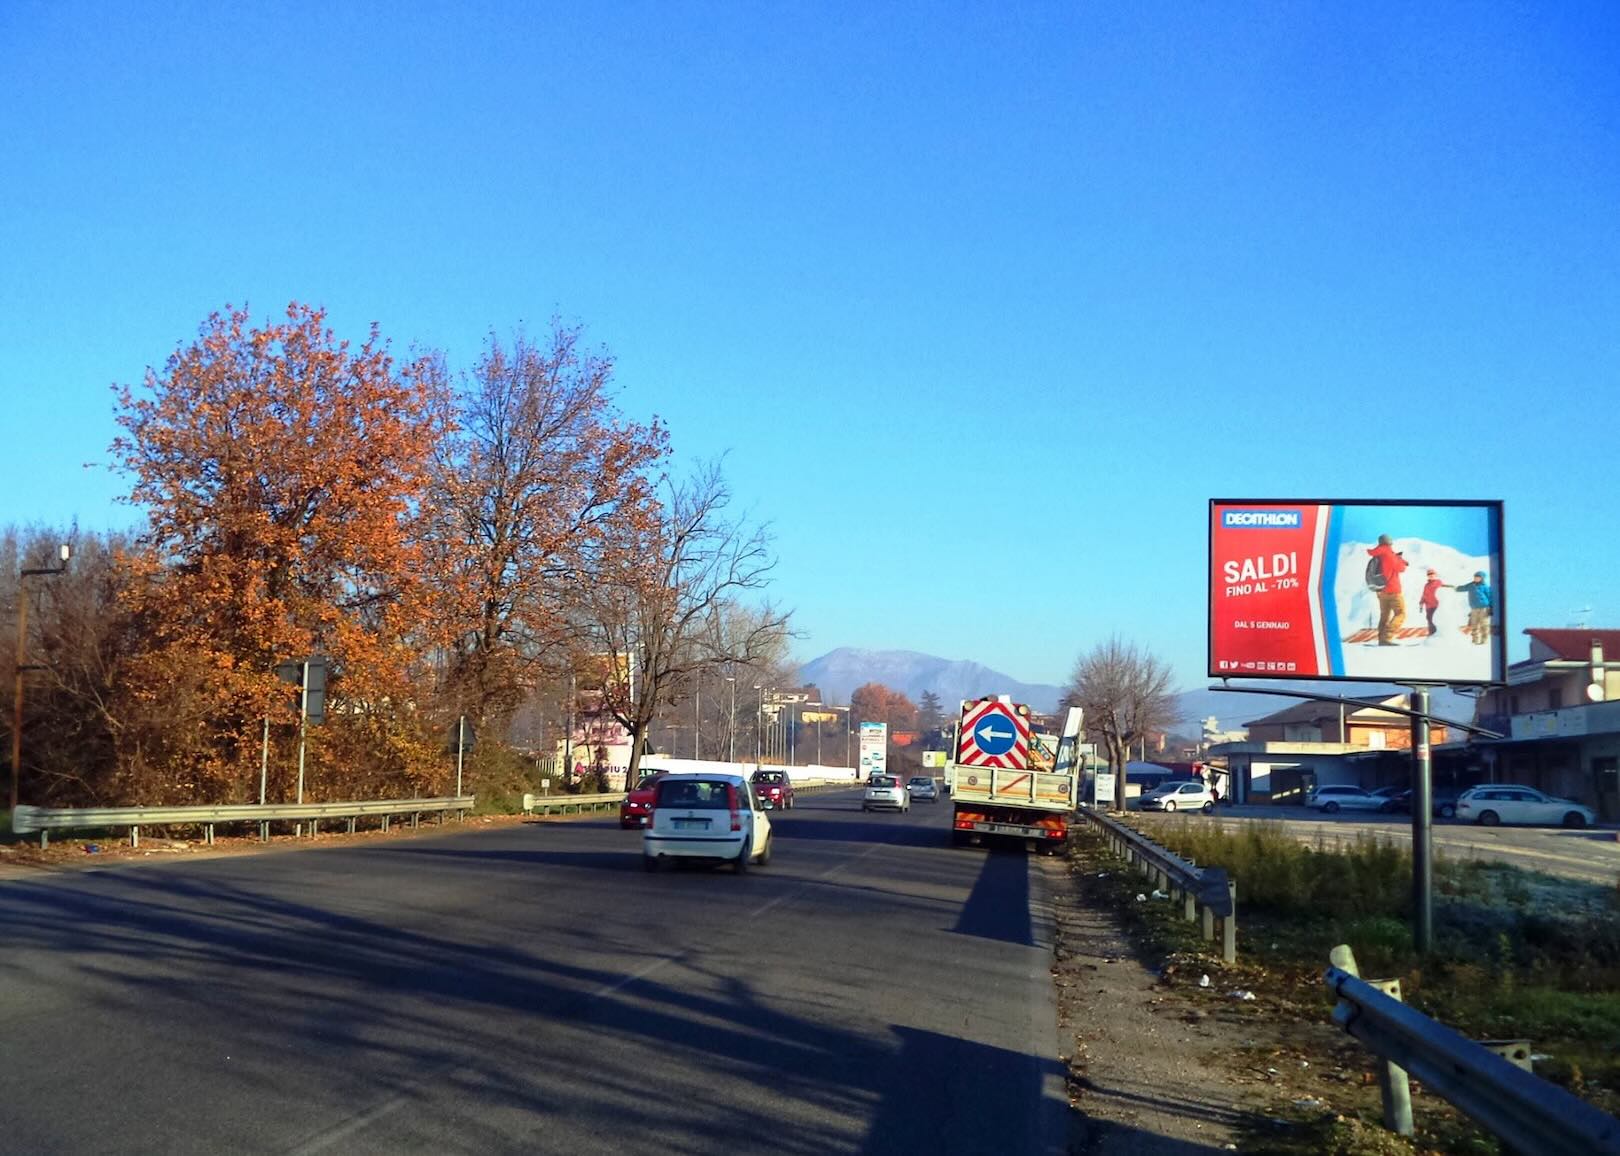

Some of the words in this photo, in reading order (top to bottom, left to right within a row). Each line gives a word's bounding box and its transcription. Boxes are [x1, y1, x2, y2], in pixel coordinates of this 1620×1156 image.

[1226, 513, 1298, 525] DECATHLON
[1223, 552, 1297, 584] SALDI
[1226, 584, 1252, 597] FINO
[1254, 582, 1268, 593] AL
[1271, 578, 1299, 590] -70%
[1234, 620, 1248, 629] DAL
[1250, 621, 1255, 629] 5
[1256, 621, 1290, 630] GENNAIO
